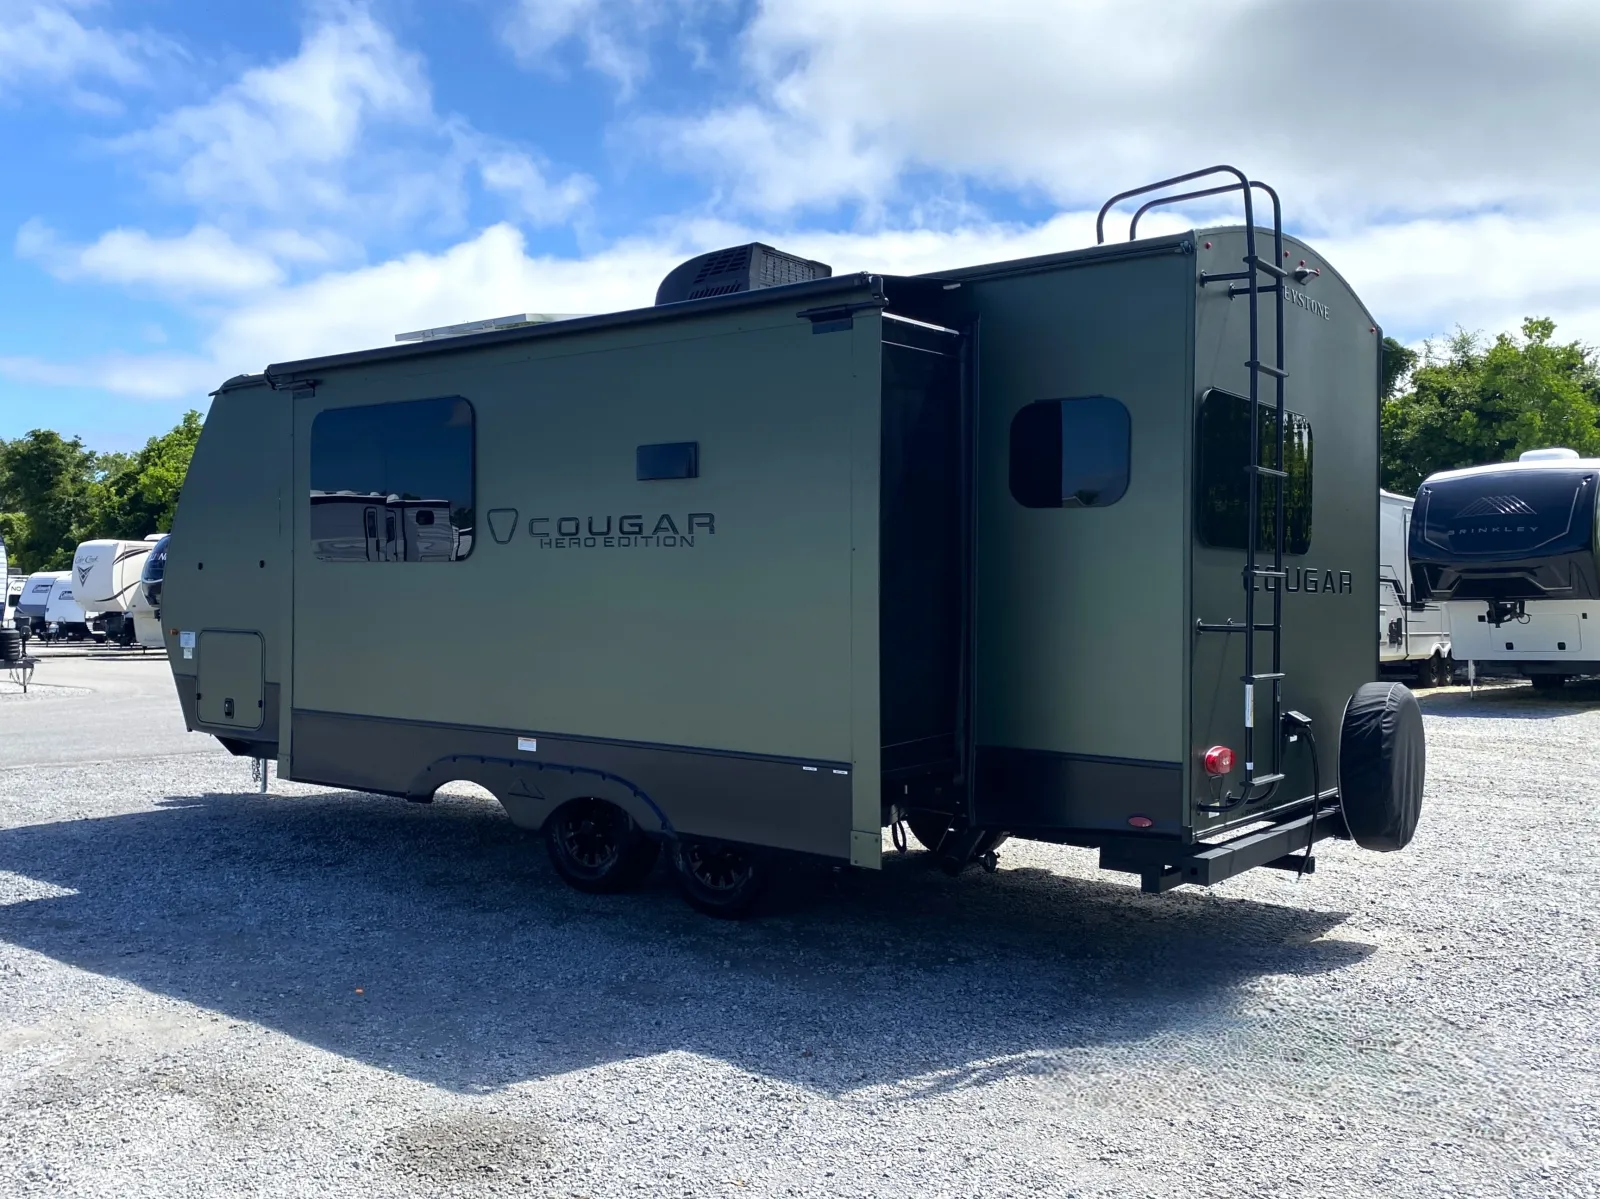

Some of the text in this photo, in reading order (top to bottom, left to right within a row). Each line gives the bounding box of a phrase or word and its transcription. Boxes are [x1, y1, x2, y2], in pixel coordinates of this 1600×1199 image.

[1282, 285, 1330, 321] EYSTONE
[528, 513, 715, 538] COUGAR
[1447, 526, 1539, 536] BRINKLEY
[540, 535, 695, 549] HERO EDITION
